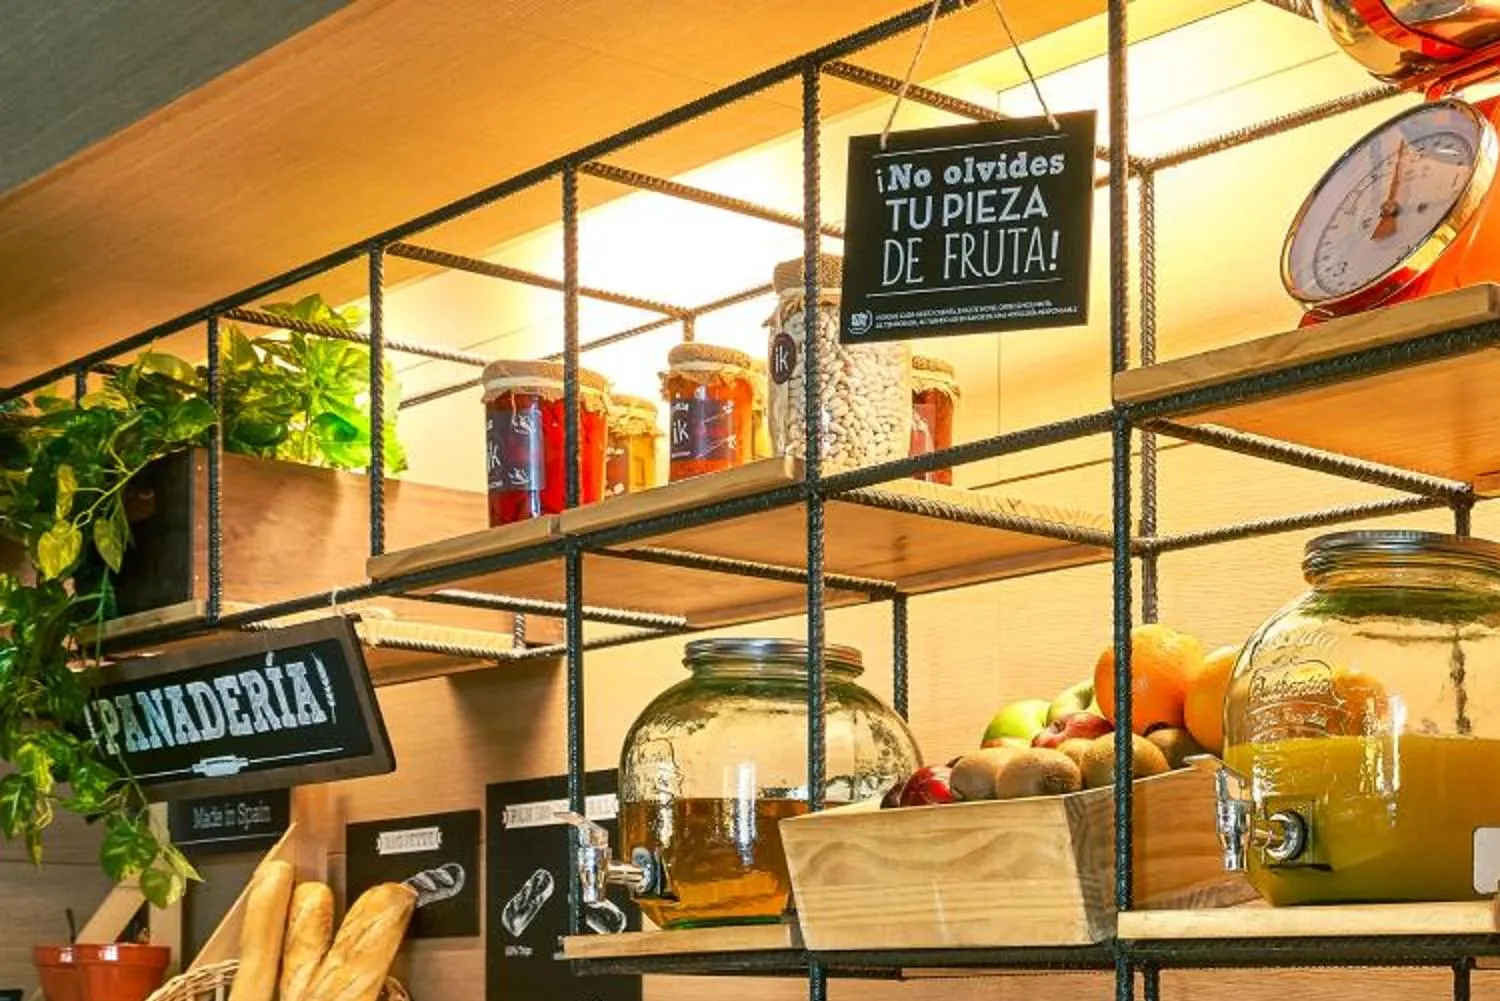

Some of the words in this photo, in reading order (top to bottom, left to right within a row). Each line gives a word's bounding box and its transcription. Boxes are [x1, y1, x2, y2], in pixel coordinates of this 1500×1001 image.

[875, 163, 933, 194] ¡No
[943, 152, 1065, 185] olvides
[885, 195, 933, 232] TU
[941, 184, 1049, 227] PIEZA
[881, 237, 924, 286] DE
[943, 226, 1060, 280] FRUTA!
[92, 651, 329, 756] PANADERÍA
[224, 802, 236, 828] in
[238, 800, 271, 832] Spain
